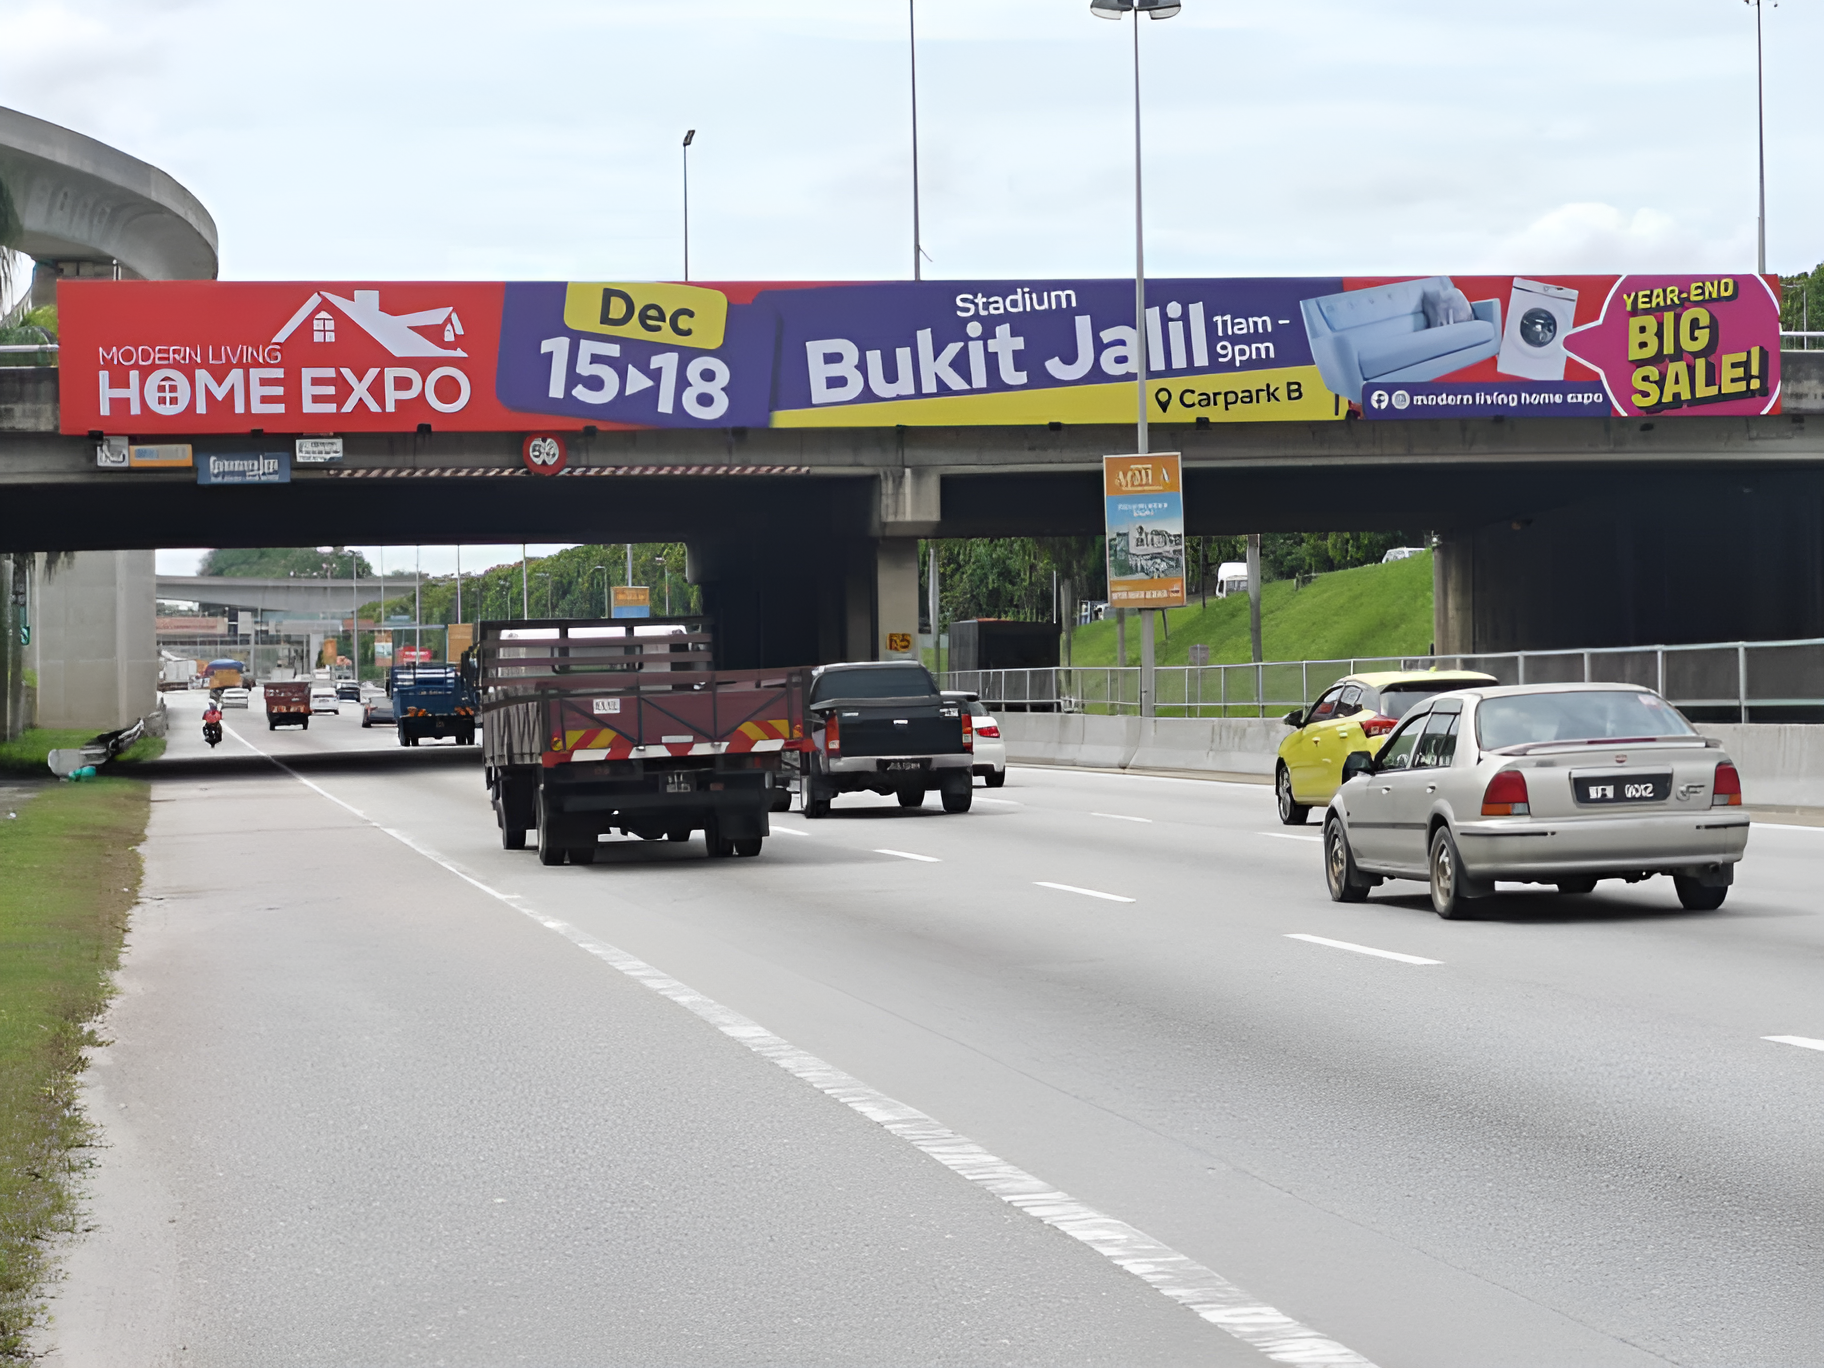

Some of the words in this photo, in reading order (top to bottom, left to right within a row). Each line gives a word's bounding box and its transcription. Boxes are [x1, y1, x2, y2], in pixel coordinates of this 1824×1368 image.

[955, 287, 1077, 319] Stadium
[1623, 278, 1735, 312] YEAR-END
[599, 287, 695, 339] Dec
[1213, 314, 1272, 338] 11am
[1628, 307, 1712, 361] BIG
[98, 344, 202, 365] MODERN
[208, 344, 282, 365] LIVING
[806, 321, 1028, 407] Bukit
[1043, 300, 1209, 382] Jalil
[1216, 341, 1275, 367] 9pm
[99, 367, 286, 415] HOME
[302, 366, 471, 413] EXPO
[540, 337, 620, 404] 15
[649, 352, 731, 420] 18
[1631, 345, 1761, 408] SALE!
[1179, 383, 1281, 410] Carpark
[1286, 381, 1304, 401] B
[1413, 392, 1472, 406] modern
[1475, 392, 1517, 407] living
[1521, 392, 1562, 406] home
